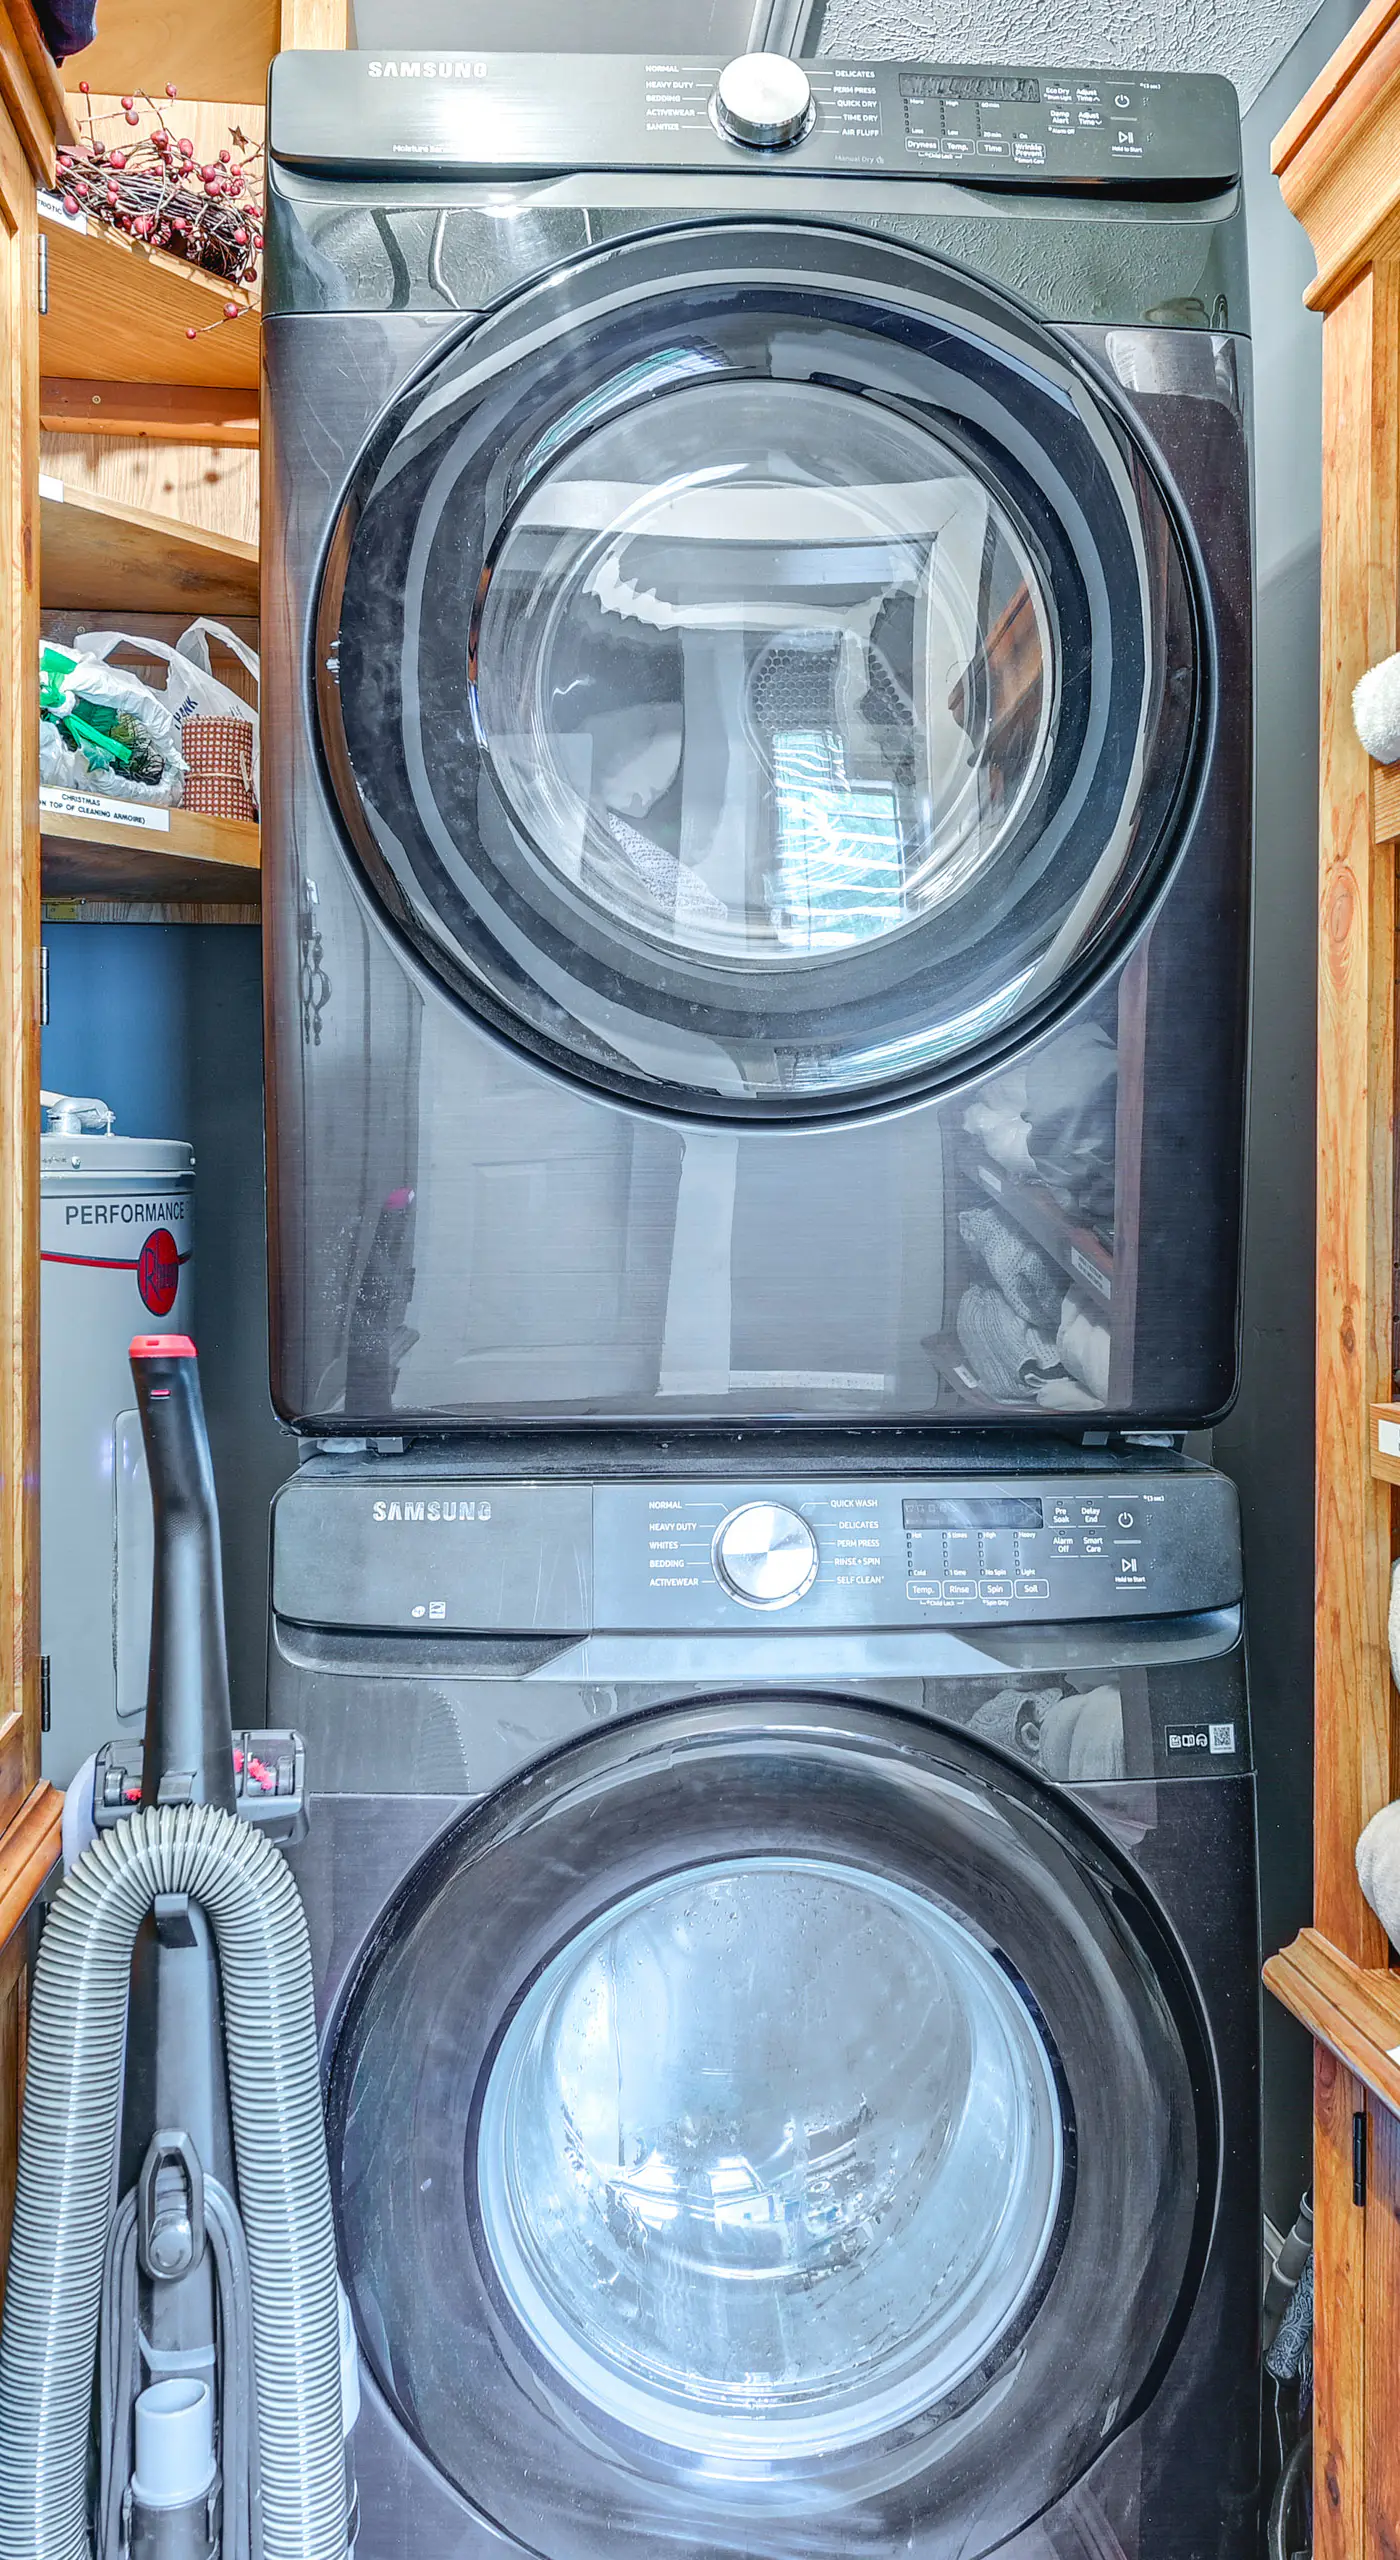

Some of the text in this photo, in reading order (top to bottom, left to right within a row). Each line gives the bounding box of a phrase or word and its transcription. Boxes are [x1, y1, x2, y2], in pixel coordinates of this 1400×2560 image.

[368, 61, 487, 78] SAMSUNG
[645, 64, 680, 73] NORMAL
[835, 70, 876, 78] DELICATES
[645, 81, 694, 89] HEAVY DUTY
[833, 86, 877, 95] PERM PRESS
[1045, 87, 1070, 97] Eco Dry
[1076, 88, 1098, 97] Adjust
[645, 94, 681, 103] BEDDING
[837, 100, 860, 108] QUICK
[945, 100, 960, 109] High
[646, 108, 696, 117] ACTIVEWEAR
[1050, 110, 1070, 119] Damp
[1078, 112, 1100, 121] Adjust
[862, 114, 878, 122] DRY
[1052, 117, 1070, 125] Alert
[1078, 118, 1096, 126] Time
[646, 122, 680, 131] SANITIZE
[842, 128, 880, 137] AIR FLUFF
[907, 140, 938, 151] Dryness
[946, 142, 969, 153] Temp.
[983, 144, 1004, 153] Time
[1014, 143, 1043, 151] Wrinkle
[1014, 150, 1044, 158] Prevent
[861, 155, 875, 164] Dry
[61, 793, 101, 806] CHRISTMAS
[50, 800, 63, 809] TOP
[65, 803, 75, 812] OF
[77, 806, 111, 818] CLEANING
[65, 1201, 185, 1225] PERFORMANCE
[648, 1501, 682, 1509] NORMAL
[830, 1499, 878, 1508] QUICK WASH
[372, 1500, 492, 1521] SAMSUNG
[1055, 1507, 1067, 1515] Pre
[1081, 1507, 1101, 1516] Delay
[649, 1522, 697, 1531] HEAVY DUTY
[838, 1521, 879, 1529] DELICATES
[983, 1532, 996, 1540] High
[1018, 1531, 1036, 1540] Heavy
[649, 1541, 679, 1549] WHITES
[857, 1539, 880, 1547] PRESS
[1052, 1537, 1074, 1545] Alarm
[1083, 1537, 1103, 1545] Smart
[1057, 1545, 1070, 1553] Off
[1086, 1545, 1102, 1553] Care
[649, 1559, 685, 1568] BEDDING
[1020, 1569, 1036, 1577] Light
[649, 1577, 699, 1587] ACTIVEWEAR
[836, 1576, 855, 1584] SELF
[912, 1585, 935, 1595] Temp.
[949, 1585, 970, 1594] Rinse
[987, 1585, 1003, 1595] Spin
[1024, 1584, 1038, 1593] Soil
